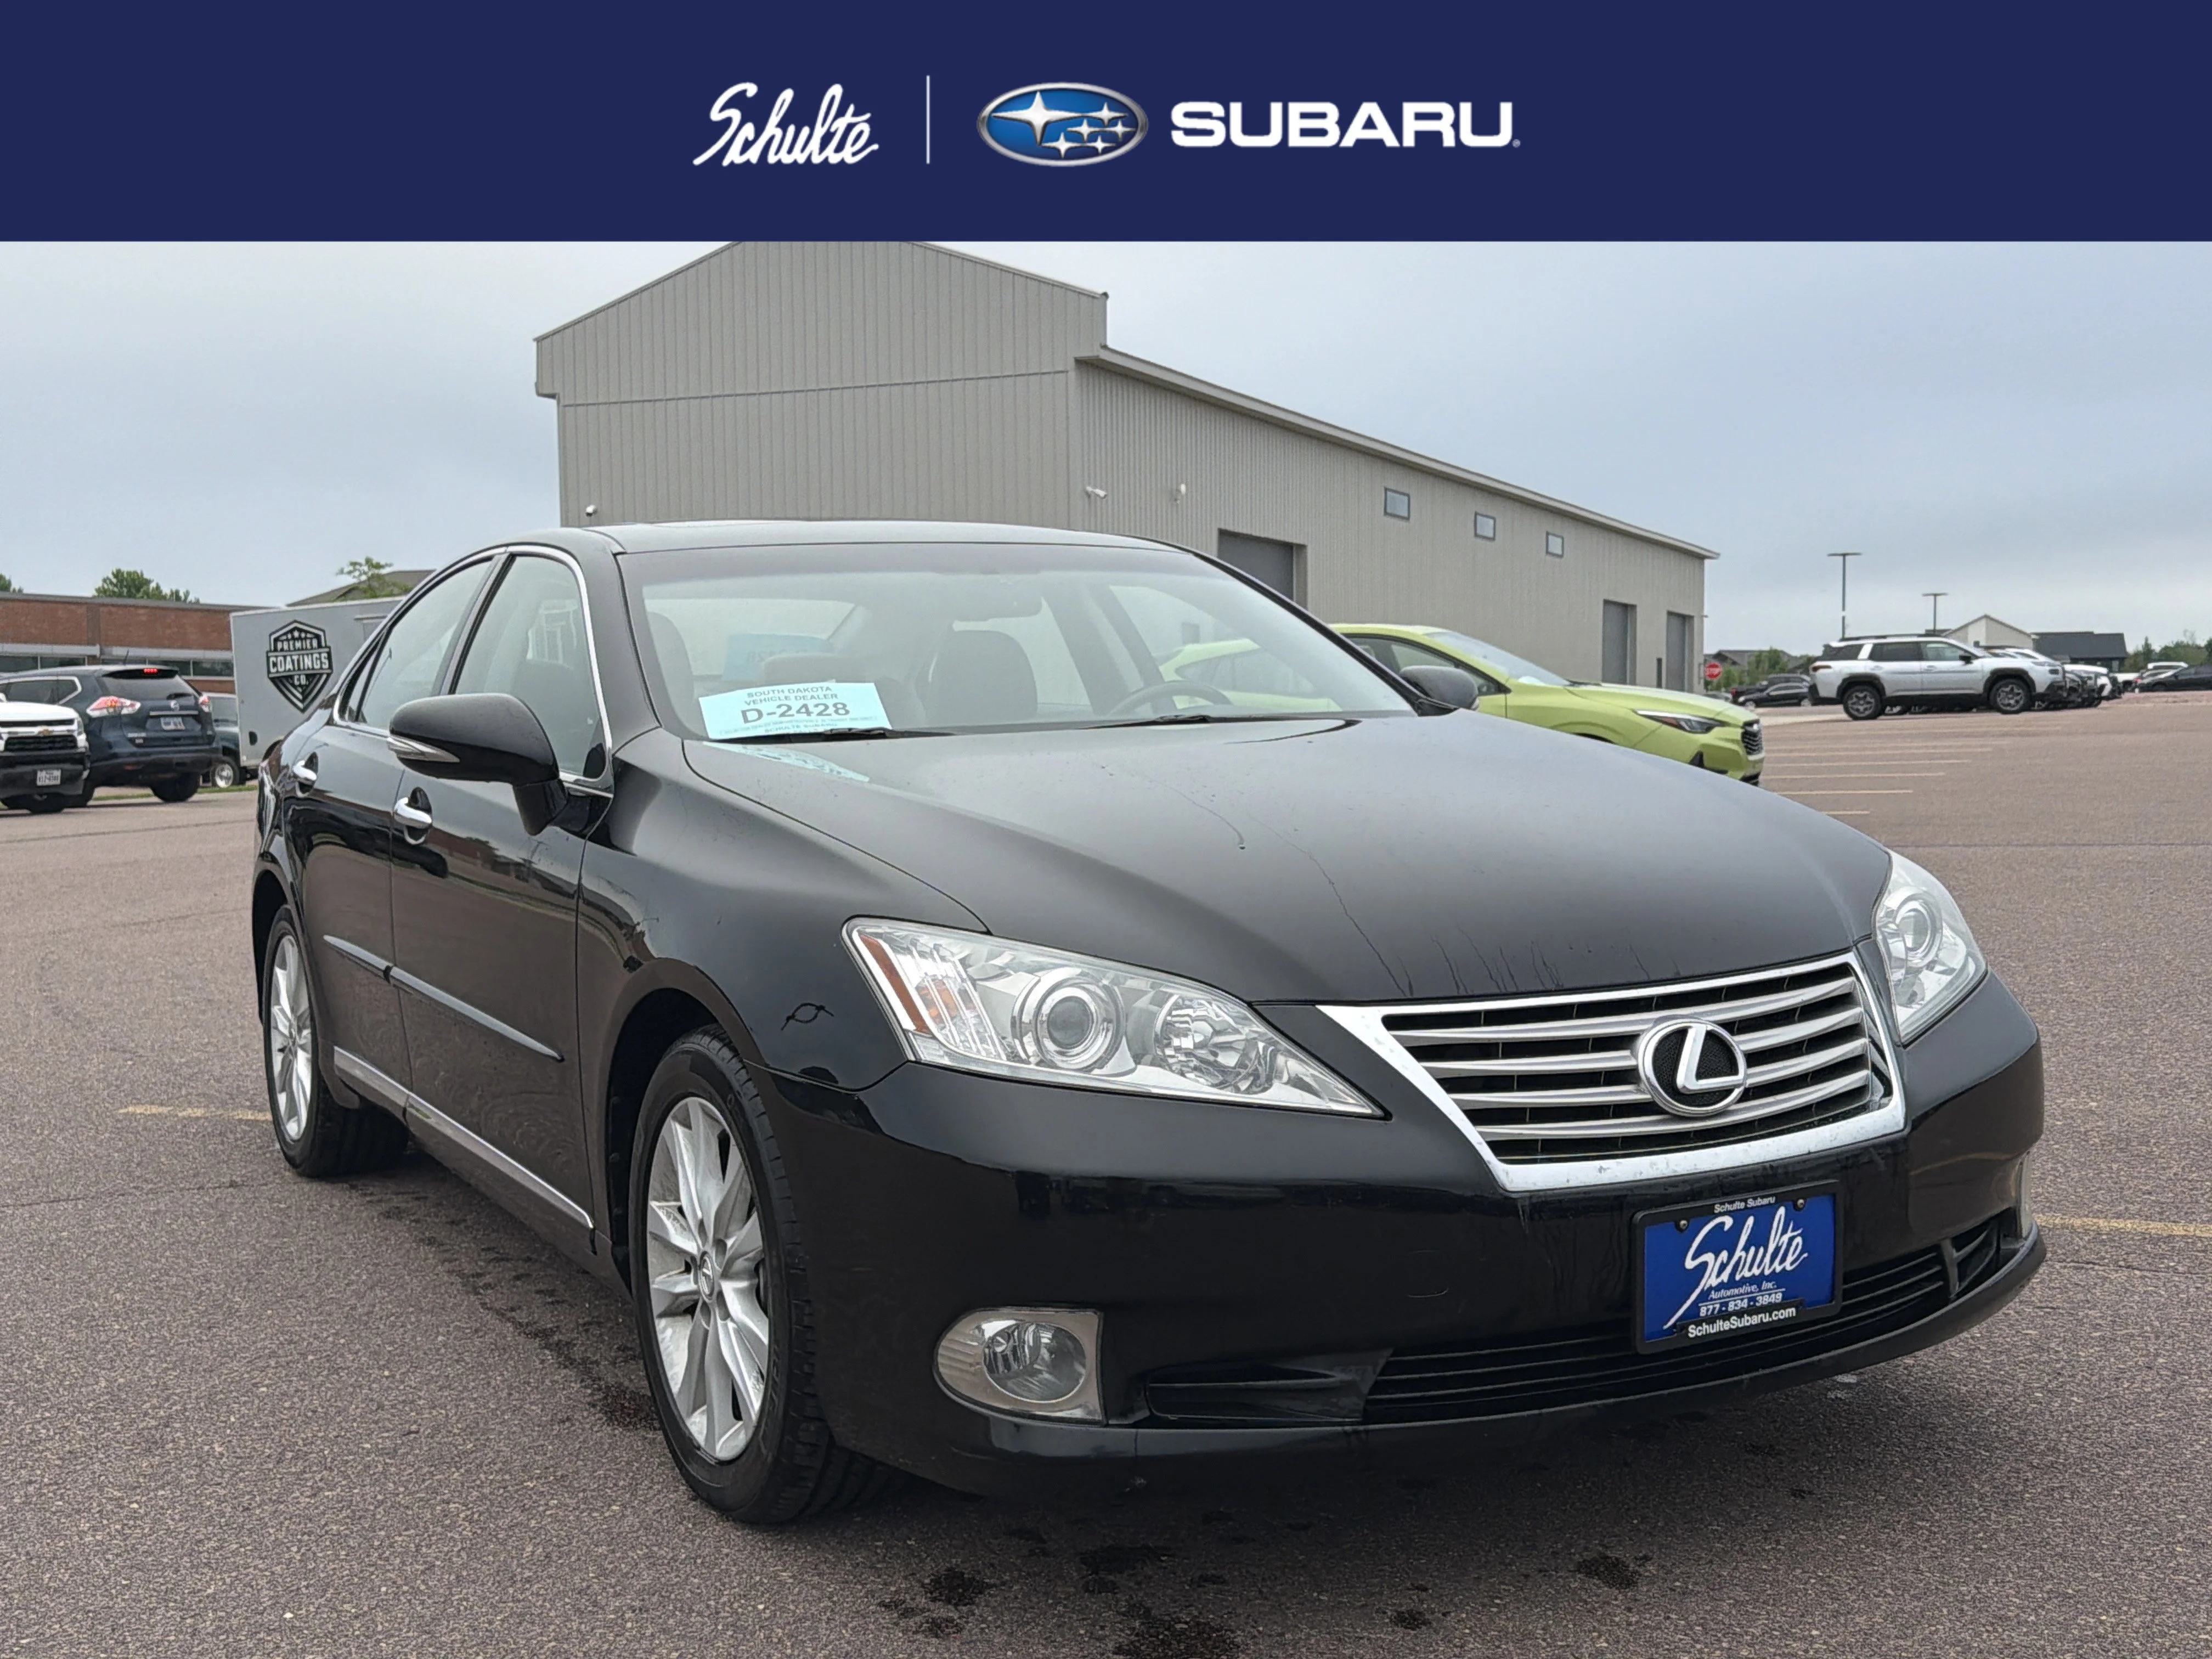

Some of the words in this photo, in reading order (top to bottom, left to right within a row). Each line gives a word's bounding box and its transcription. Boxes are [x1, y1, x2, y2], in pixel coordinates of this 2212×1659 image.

[277, 638, 318, 651] PREMIER
[269, 653, 329, 673] COATINGS
[744, 695, 792, 706] VEHICLE
[747, 689, 785, 698] SOUTH
[741, 702, 850, 724] D-2428
[1714, 1200, 1745, 1214] Schulte
[1747, 1197, 1776, 1208] Subaru
[1663, 1206, 1808, 1330] Schulte
[1761, 1280, 1777, 1290] Inc.
[1699, 1304, 1720, 1317] 877
[1728, 1297, 1747, 1312] 834
[1756, 1293, 1782, 1307] 3849
[1688, 1307, 1796, 1338] SchulteSubaru.com
